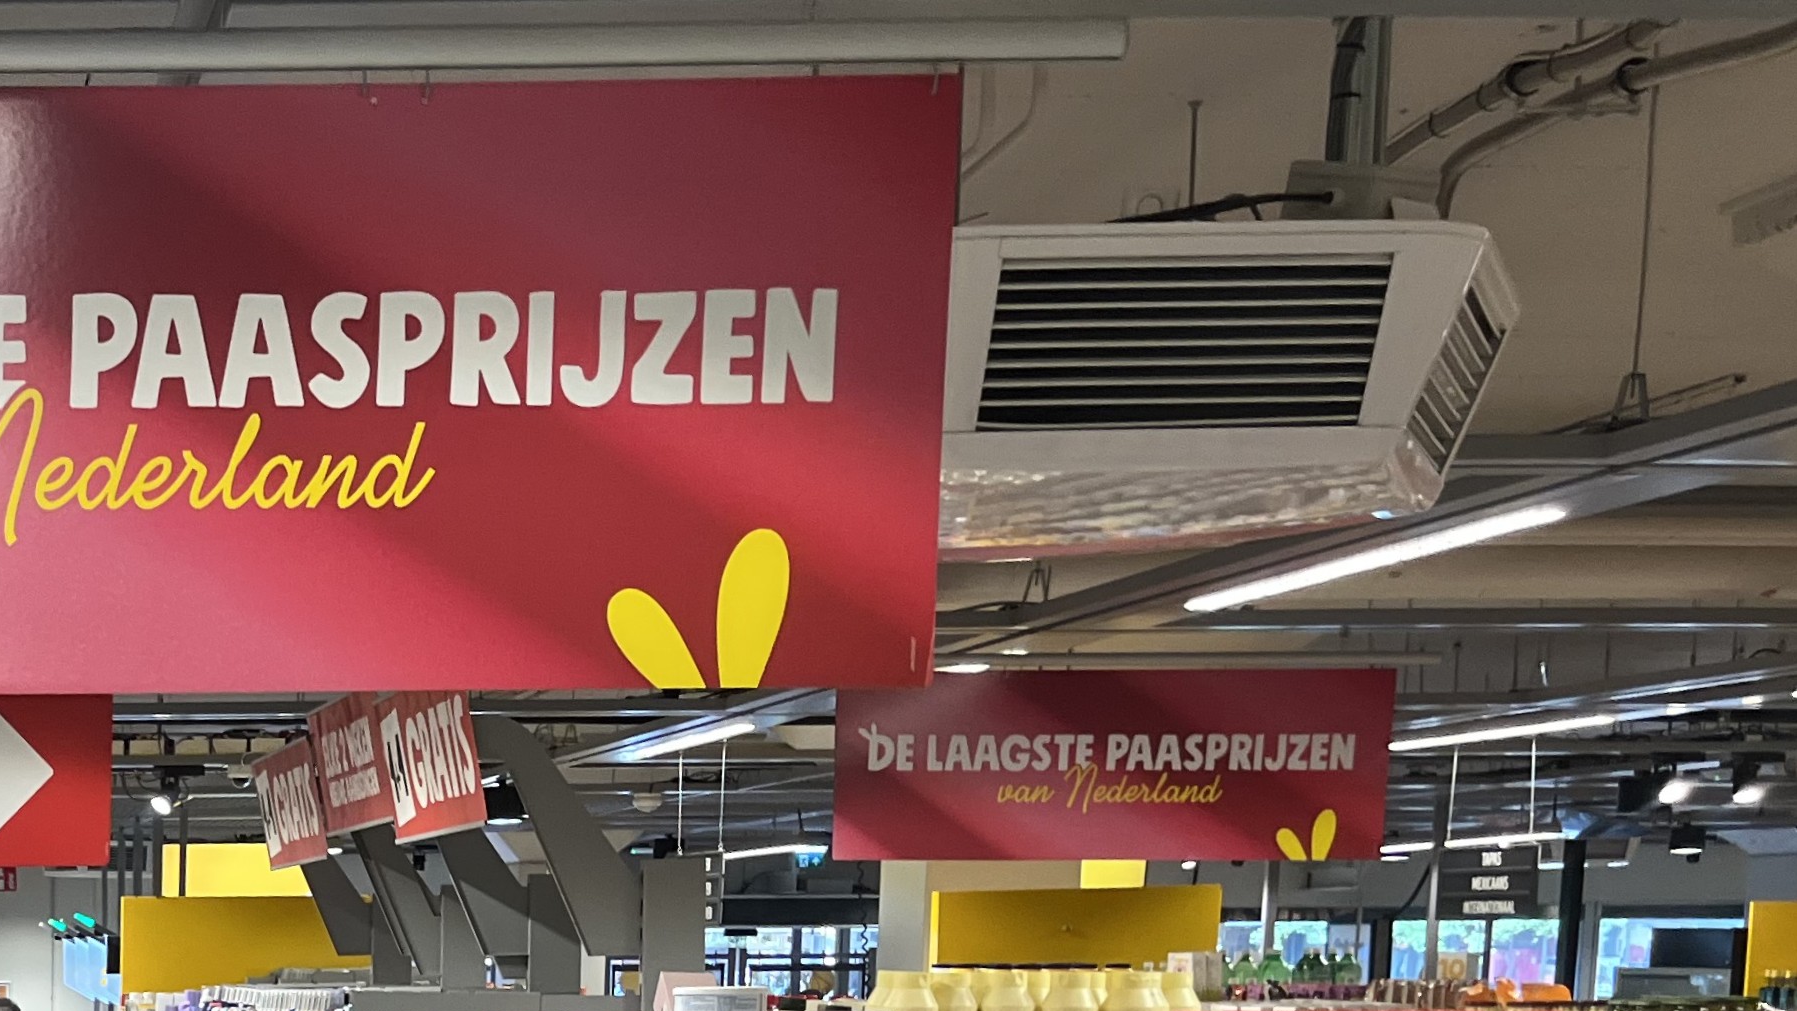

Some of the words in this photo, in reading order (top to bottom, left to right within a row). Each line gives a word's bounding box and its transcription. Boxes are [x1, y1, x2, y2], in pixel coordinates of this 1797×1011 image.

[69, 287, 838, 411] PAASPRIJZEN
[405, 695, 476, 809] GRATIS
[864, 731, 914, 772] DE
[927, 734, 1095, 772] LAAGSTE
[1106, 733, 1356, 772] PAASPRIJZEN
[997, 783, 1056, 804] van
[1063, 762, 1223, 814] Nederland
